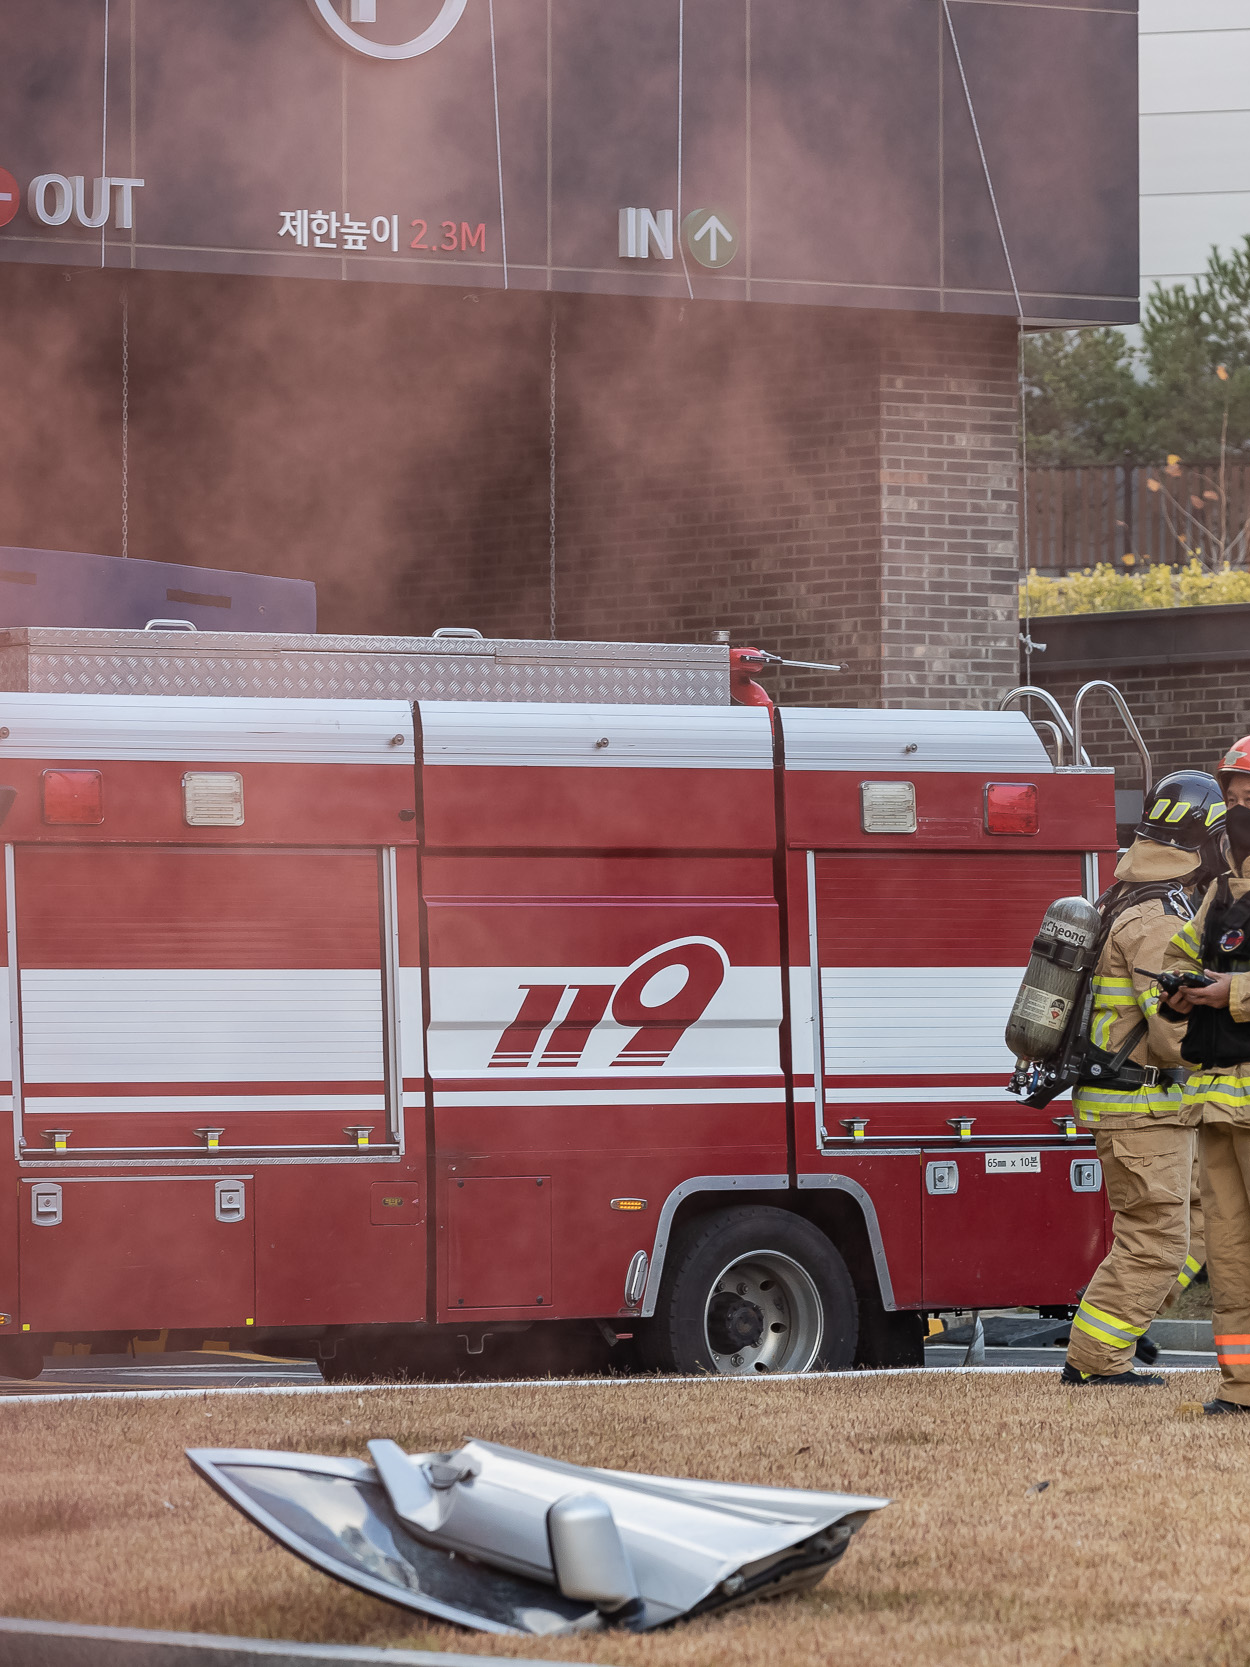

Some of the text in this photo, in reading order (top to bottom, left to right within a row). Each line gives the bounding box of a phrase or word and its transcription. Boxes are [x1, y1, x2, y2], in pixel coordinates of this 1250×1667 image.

[28, 173, 145, 229] OUT
[278, 209, 486, 252] 제한높이 2.3M
[618, 206, 673, 259] IN
[487, 942, 725, 1068] 119
[1019, 1156, 1039, 1168] 10본
